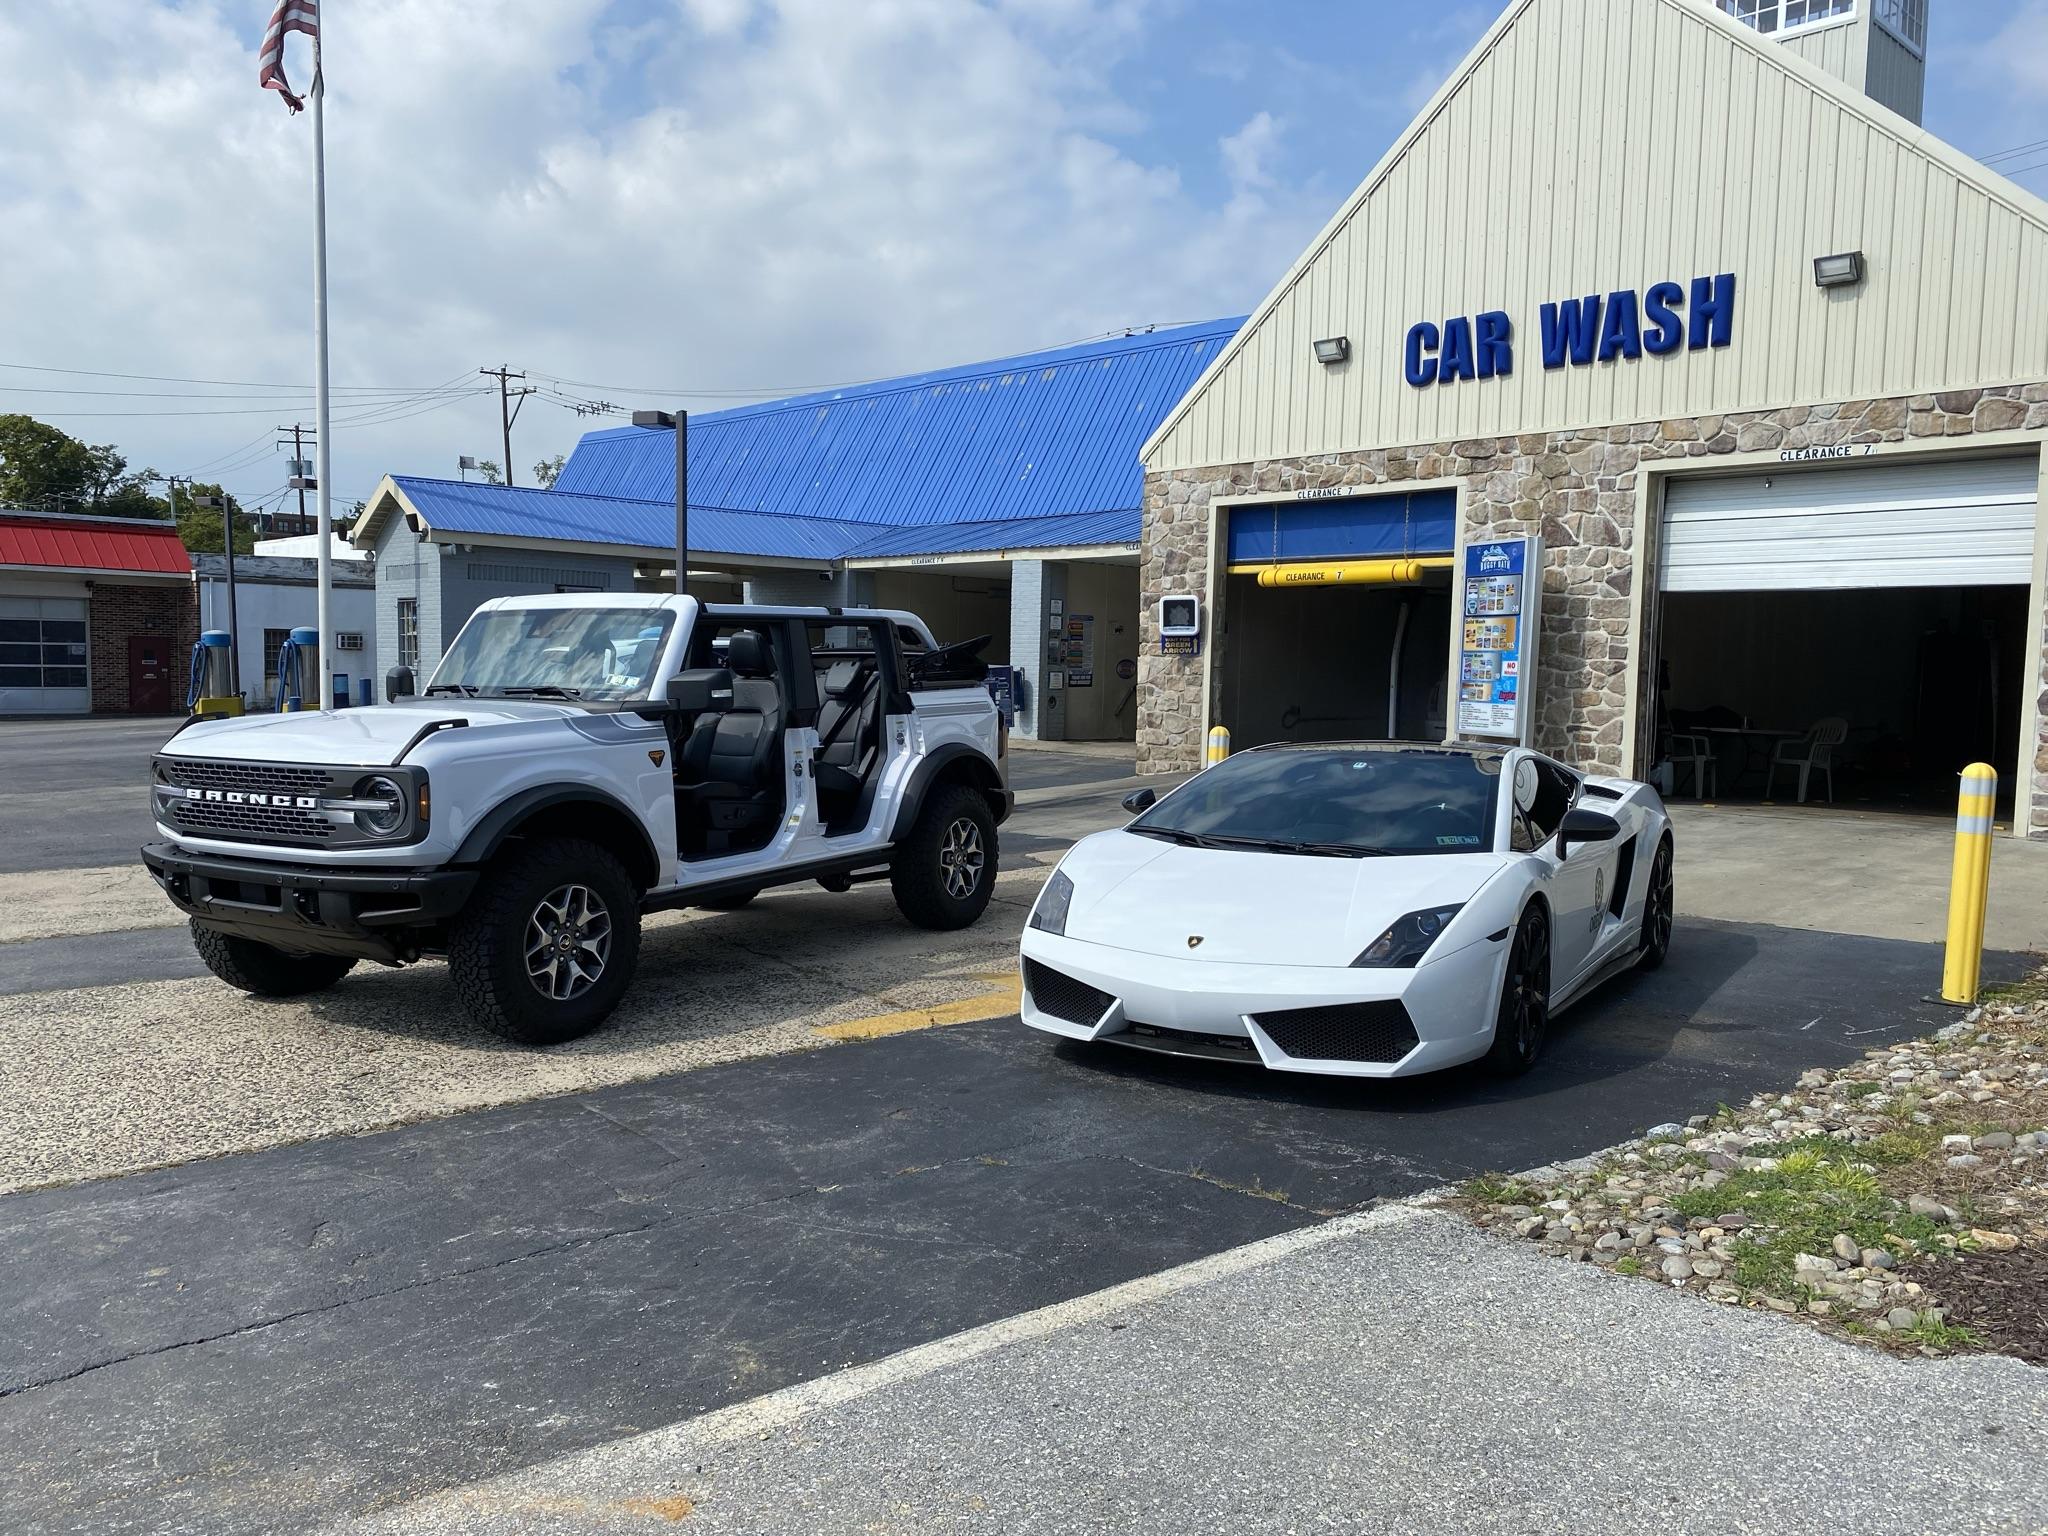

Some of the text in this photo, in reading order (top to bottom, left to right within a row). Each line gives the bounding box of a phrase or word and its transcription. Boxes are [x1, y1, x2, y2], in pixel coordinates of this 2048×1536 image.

[1404, 273, 1735, 388] CAR WASH
[1780, 446, 1852, 461] CLEARANCE
[1297, 488, 1342, 499] CLEARANCE
[1285, 571, 1325, 582] CLEARANCE
[186, 788, 317, 809] BRONCO
